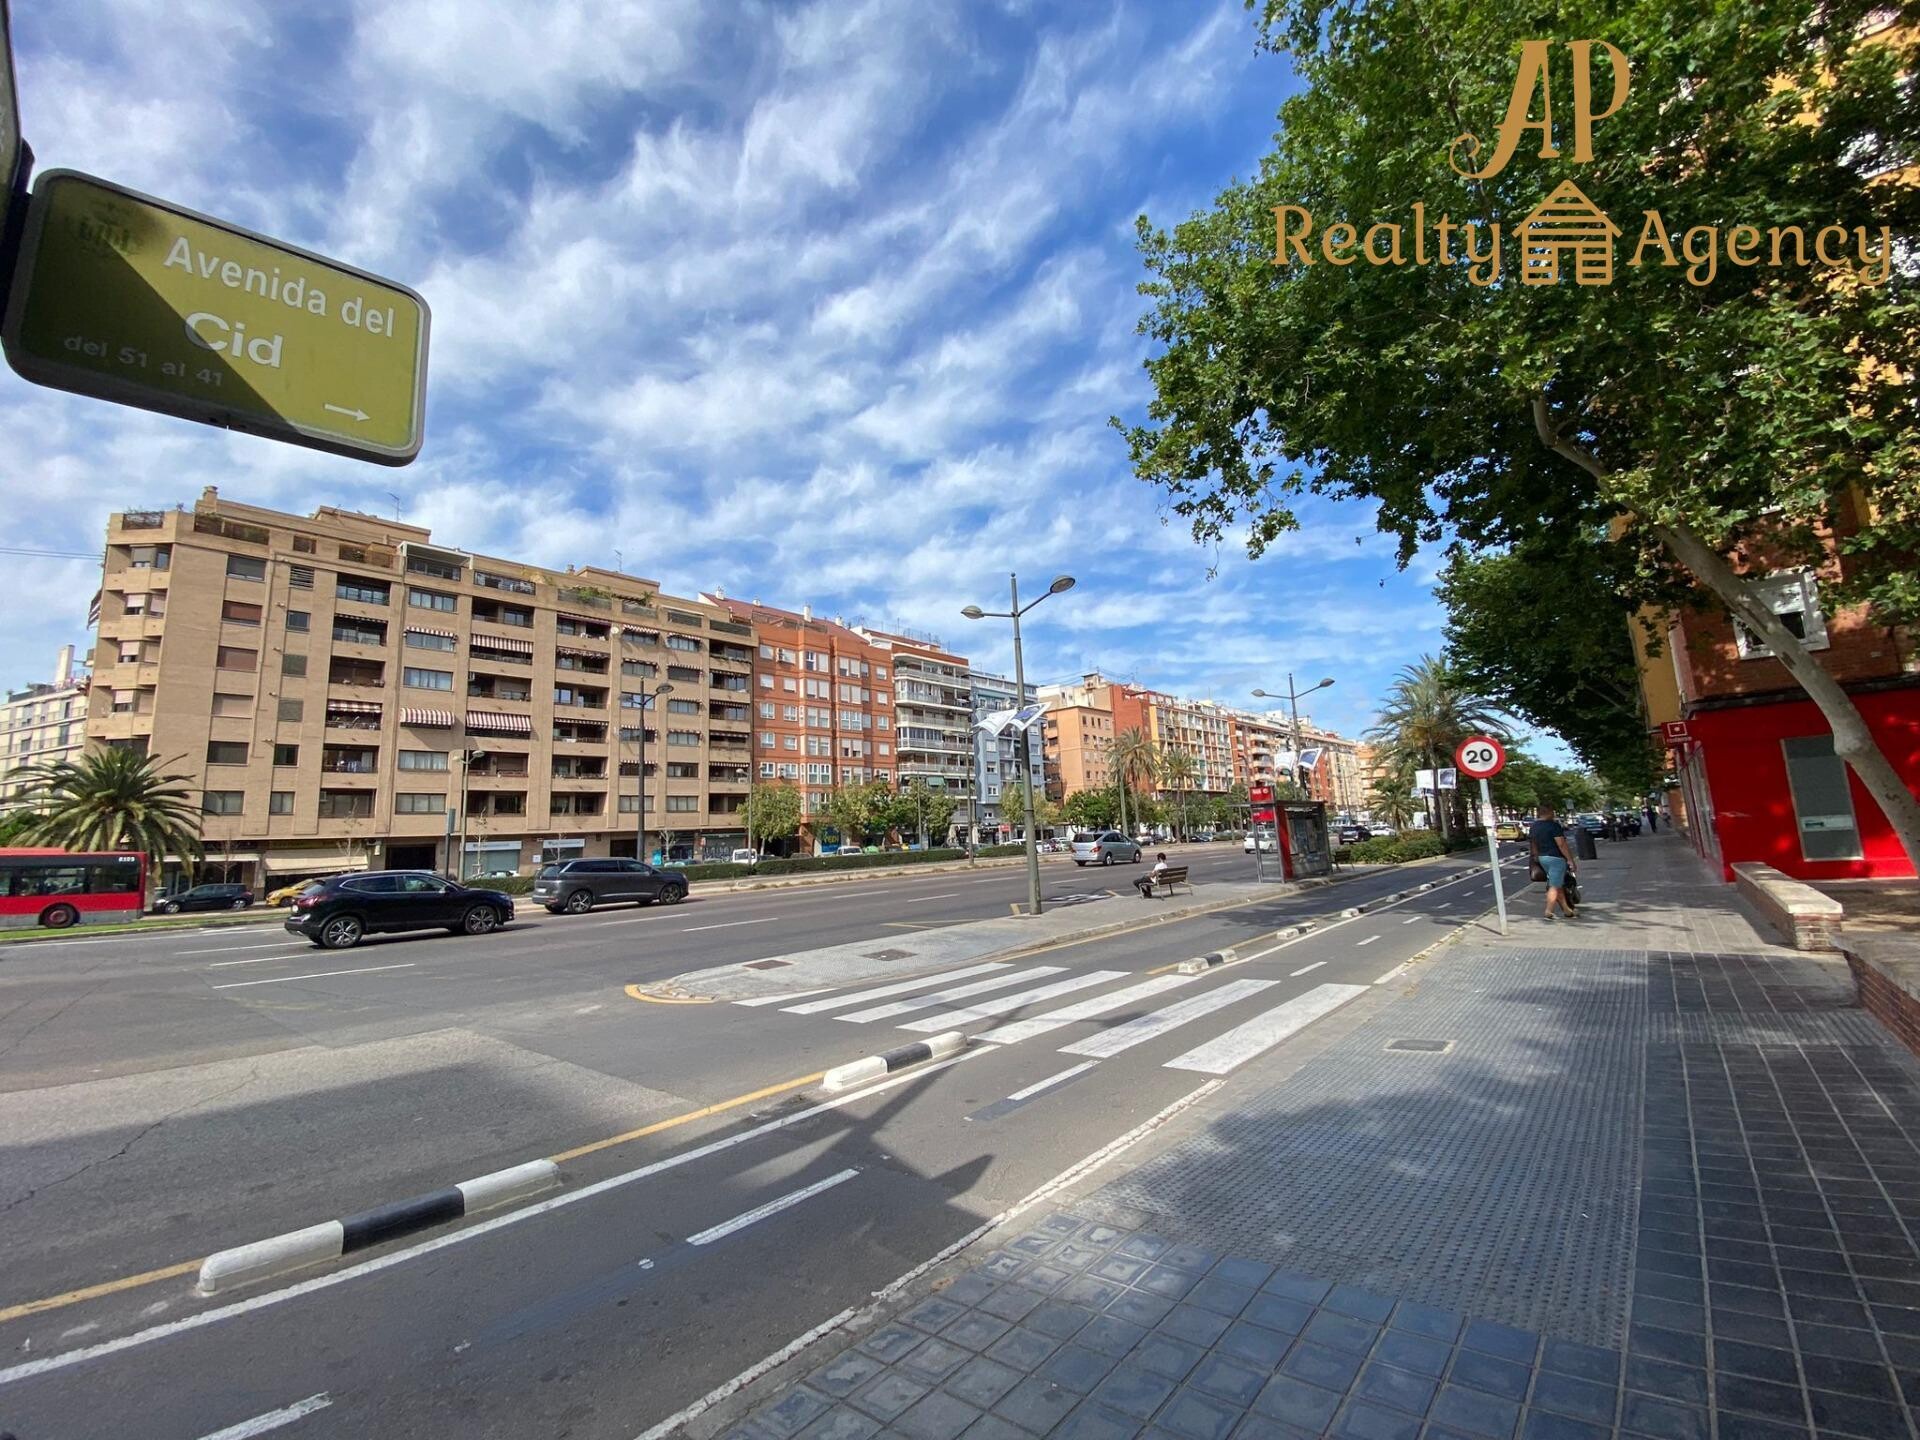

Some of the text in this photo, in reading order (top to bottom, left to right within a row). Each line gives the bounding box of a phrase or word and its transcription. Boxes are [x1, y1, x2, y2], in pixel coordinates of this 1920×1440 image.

[164, 236, 395, 338] Avenida del
[63, 335, 225, 387] del 51 al 41
[185, 312, 284, 368] Cid
[1466, 748, 1493, 764] 20
